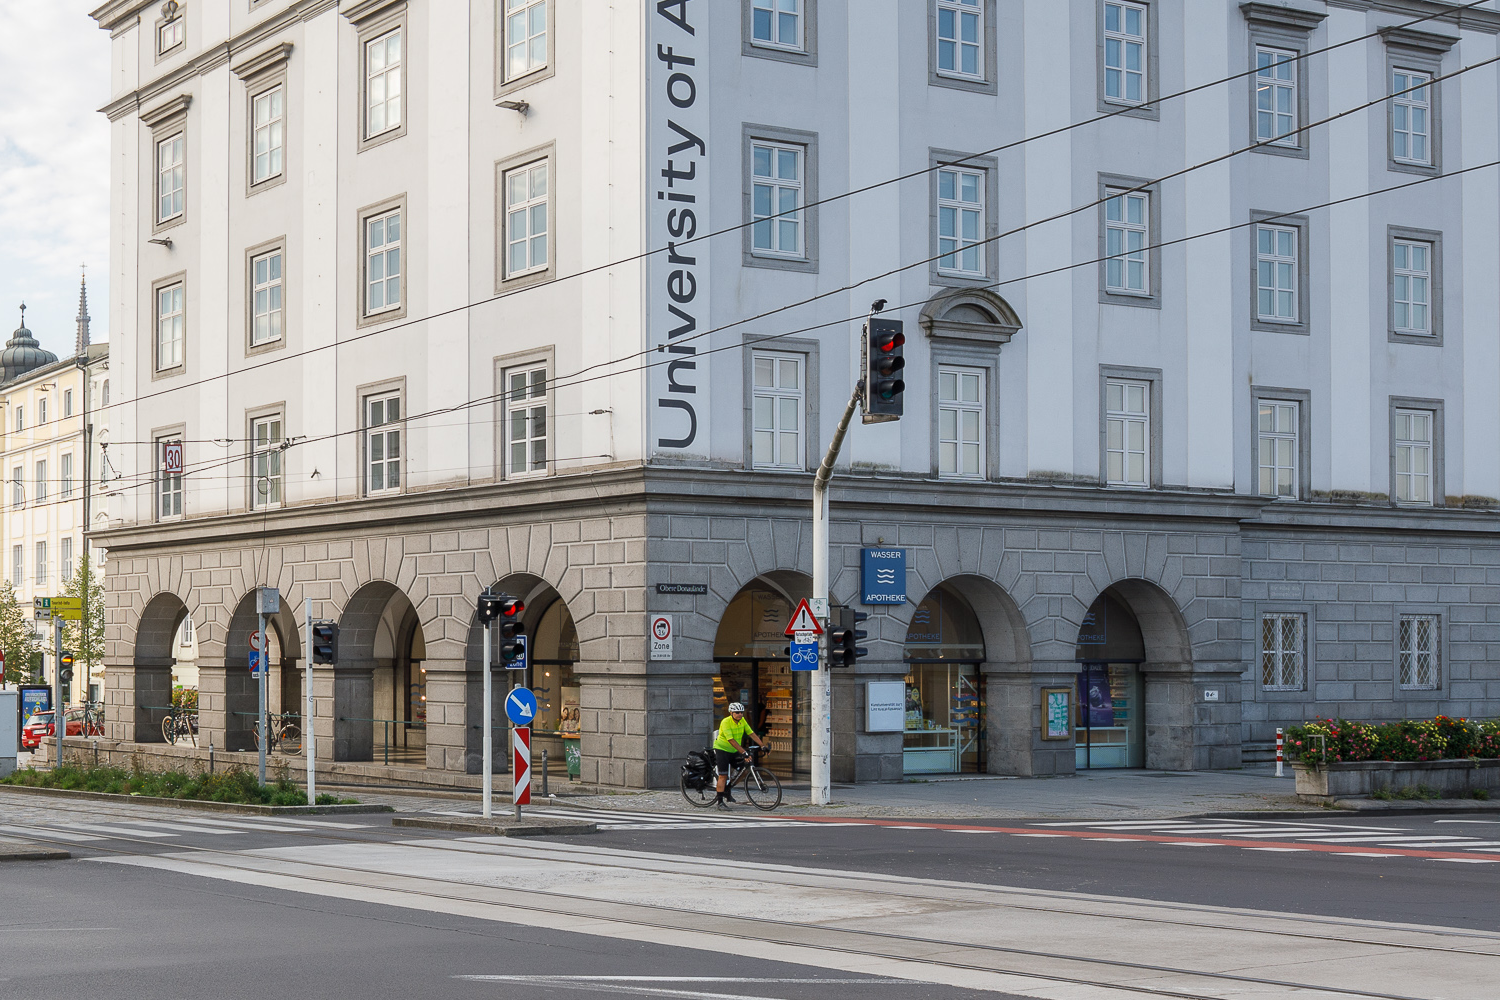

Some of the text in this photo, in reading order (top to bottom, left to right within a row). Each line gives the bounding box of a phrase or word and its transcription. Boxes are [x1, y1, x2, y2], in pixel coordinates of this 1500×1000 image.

[657, 43, 697, 109] of
[658, 119, 706, 448] University
[167, 449, 180, 469] 30
[870, 551, 902, 559] WASSER
[660, 584, 706, 593] Obere Donaulände
[866, 594, 906, 602] APOTHEKE
[654, 641, 670, 650] Zone
